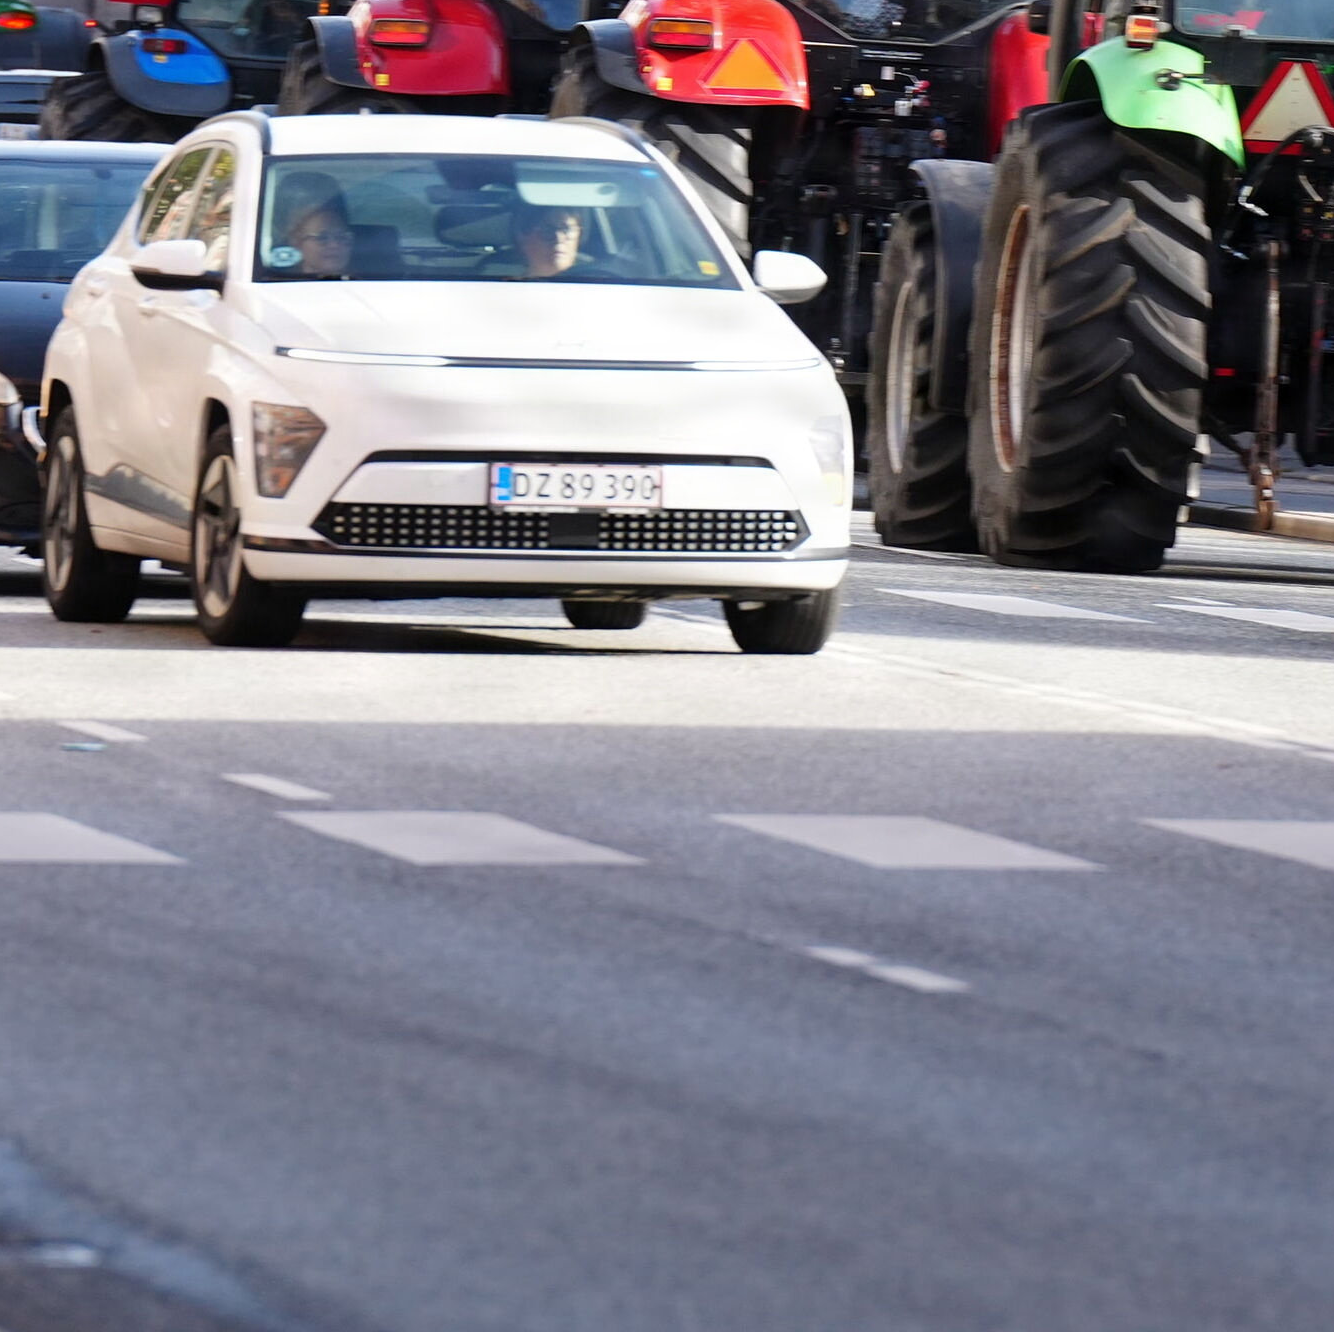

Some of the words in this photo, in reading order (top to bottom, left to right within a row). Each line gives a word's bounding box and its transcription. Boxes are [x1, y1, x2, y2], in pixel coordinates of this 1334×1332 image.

[513, 472, 551, 498] DZ
[561, 473, 595, 499] 89
[604, 473, 655, 500] 390
